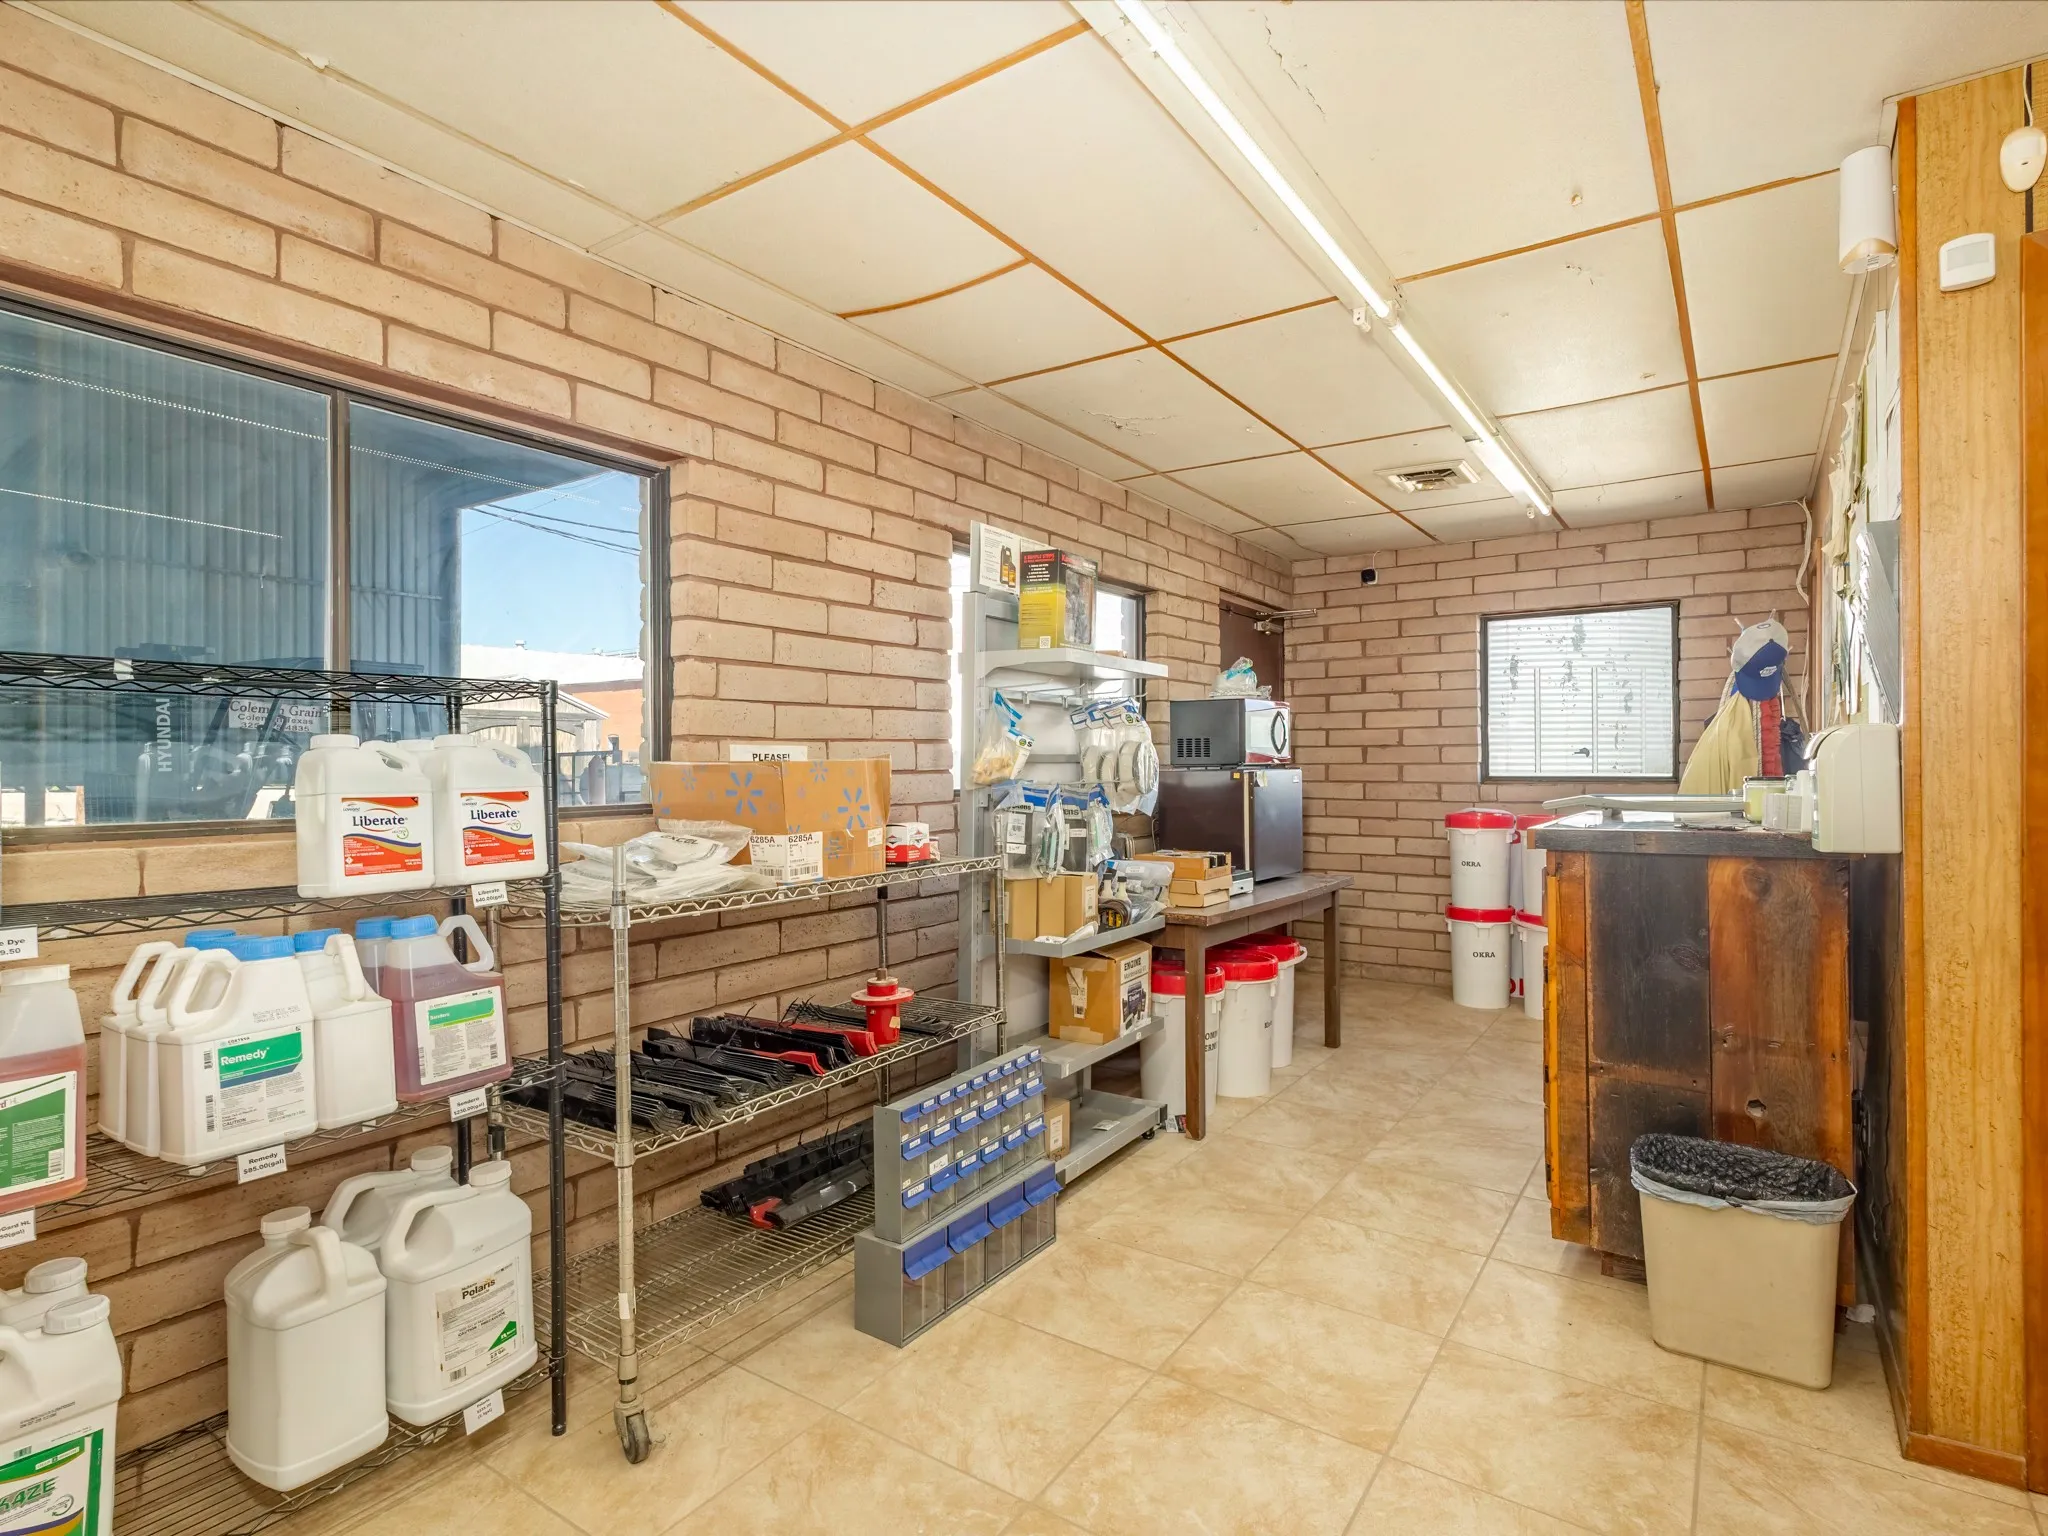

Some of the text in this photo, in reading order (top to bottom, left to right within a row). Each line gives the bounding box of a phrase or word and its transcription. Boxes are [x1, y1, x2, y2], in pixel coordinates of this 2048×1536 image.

[230, 700, 322, 718] Colemn Grain
[156, 698, 173, 772] HYUNDAI
[752, 753, 790, 761] PLEASE!
[352, 815, 406, 827] Liberate
[470, 809, 519, 821] Liberate
[749, 835, 776, 844] 6285A
[788, 833, 813, 843] 6285A
[477, 887, 501, 896] Liberate
[7, 938, 26, 946] Dye
[1124, 956, 1141, 971] ENGINE
[220, 1049, 268, 1066] Remedy
[456, 1097, 480, 1107] Sendero
[248, 1151, 278, 1165] Remedy
[242, 1158, 285, 1175] $85.00(gal)
[461, 1279, 496, 1300] Polaris
